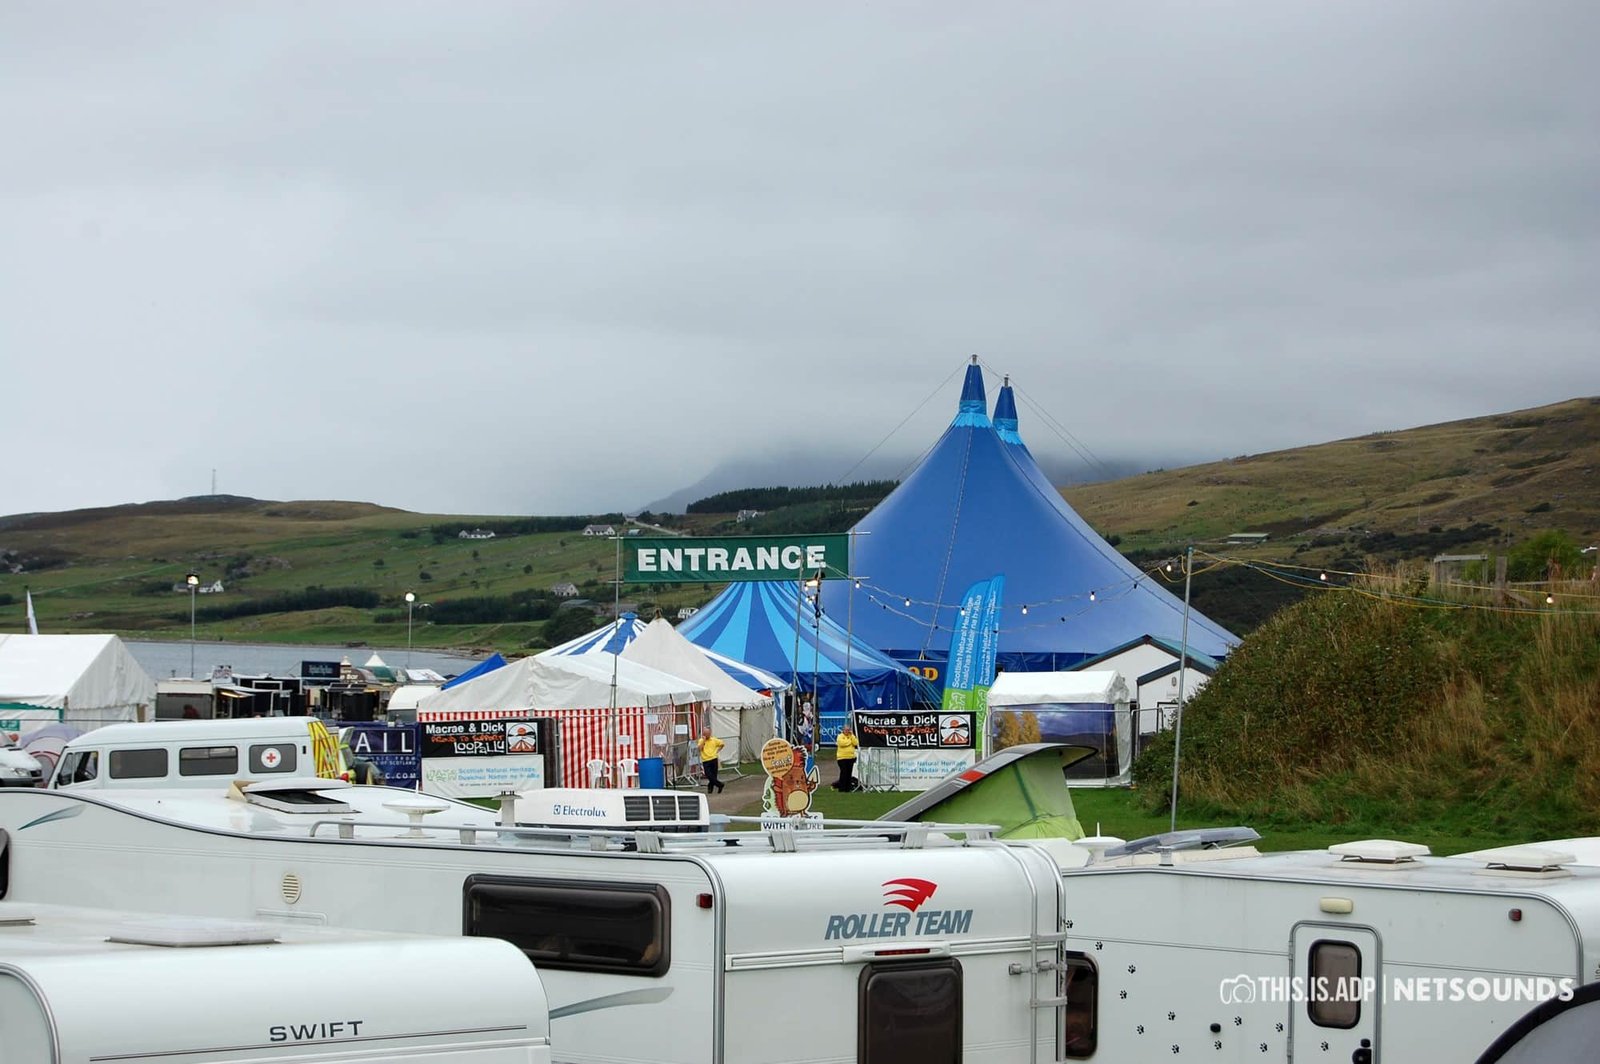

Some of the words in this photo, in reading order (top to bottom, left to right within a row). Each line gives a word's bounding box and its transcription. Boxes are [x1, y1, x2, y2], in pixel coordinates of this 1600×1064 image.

[637, 545, 826, 572] ENTRANCE
[957, 629, 968, 657] Natural
[952, 656, 963, 688] Scottish
[960, 654, 972, 689] Dualchas
[425, 723, 465, 734] Macrae
[468, 723, 477, 732] &
[481, 722, 504, 732] Dick
[858, 714, 896, 725] Macrae
[901, 715, 909, 725] &
[913, 714, 937, 724] Dick
[354, 732, 413, 753] AIL
[563, 805, 607, 817] Electrolux
[763, 822, 786, 830] WITH
[824, 912, 911, 940] ROLLER
[915, 909, 973, 935] TEAM
[269, 1020, 363, 1042] SWIFT
